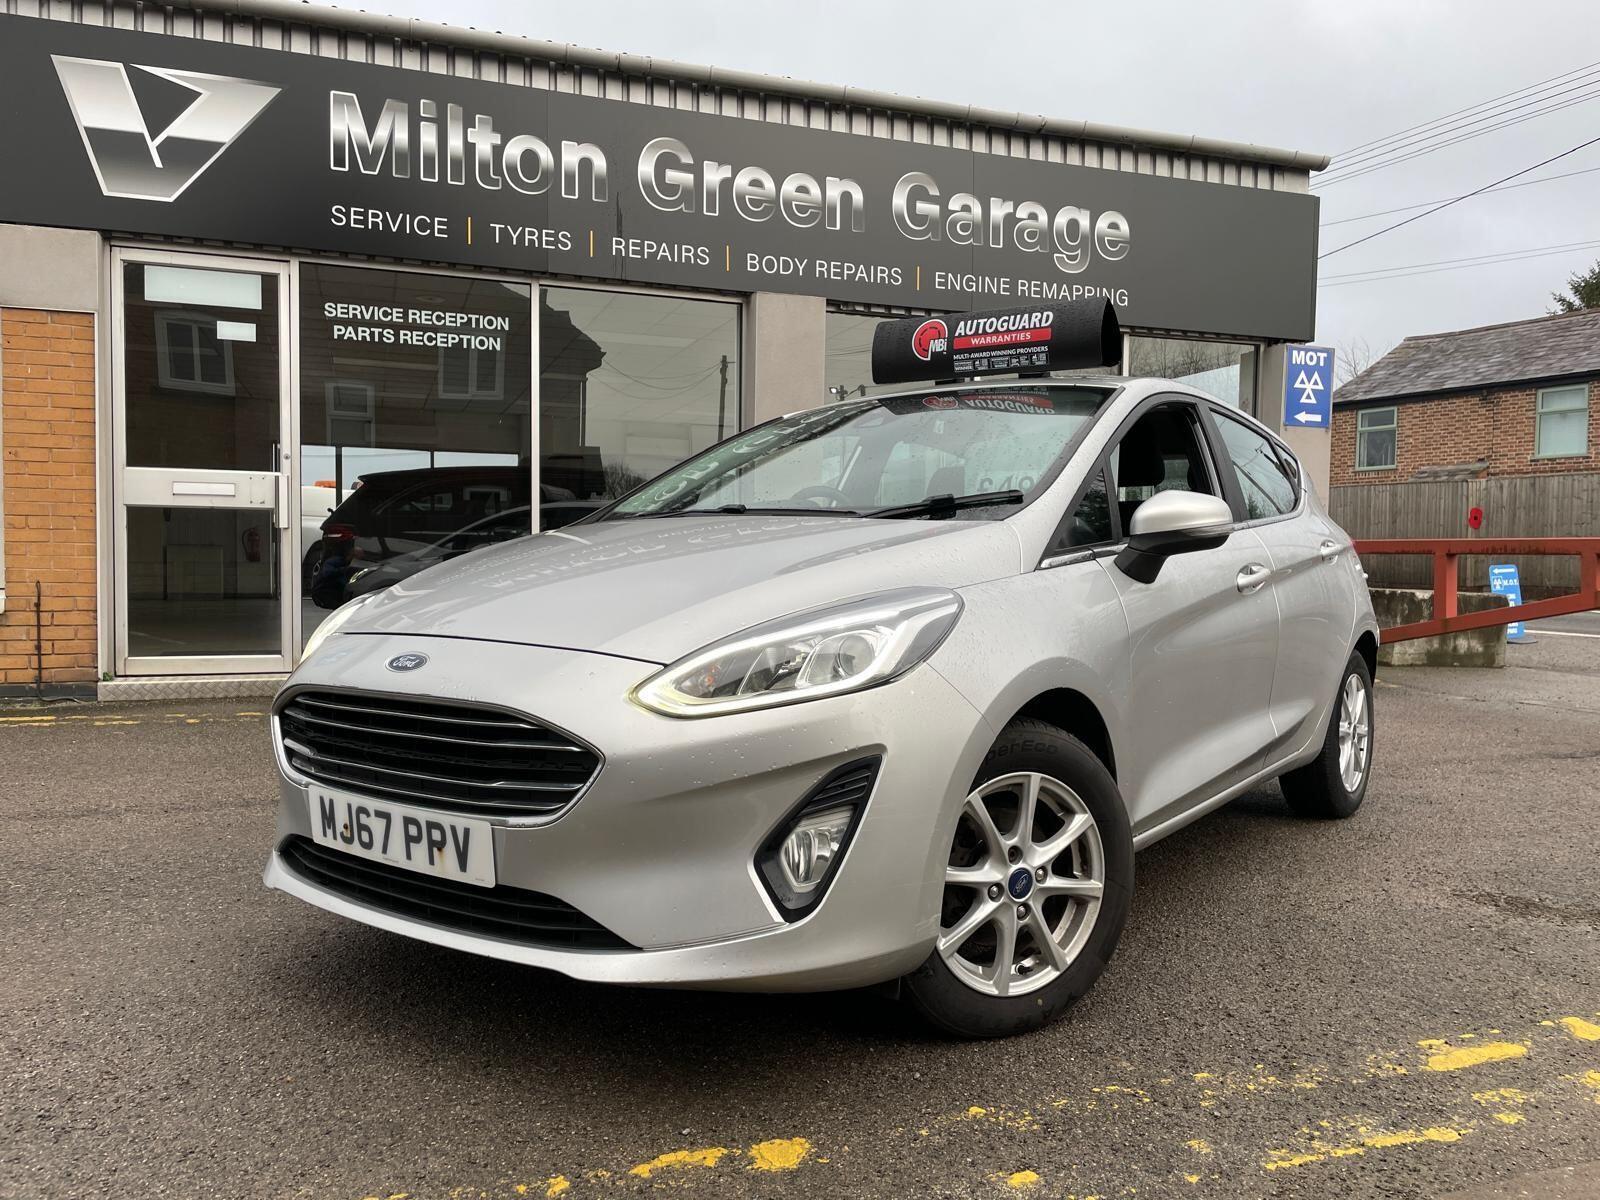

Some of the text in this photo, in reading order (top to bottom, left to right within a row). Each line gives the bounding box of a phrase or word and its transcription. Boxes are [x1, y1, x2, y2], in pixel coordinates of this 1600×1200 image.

[330, 90, 1130, 274] Milton Green Garage
[330, 205, 1128, 307] SERVICE TYRES REPAIRS BODY REPAIRS ENGINE REMAPPING
[324, 302, 510, 331] SERVICE RECEPTION
[954, 311, 1054, 337] AUTOGUARD
[333, 325, 501, 351] PARTS RECEPTION
[970, 332, 1031, 345] WARRANTIES
[990, 348, 1016, 357] WINNING
[1016, 345, 1049, 354] PROVIDERS
[1292, 349, 1328, 367] MOT
[393, 655, 420, 668] Ford
[319, 795, 471, 873] MJ67 PPV
